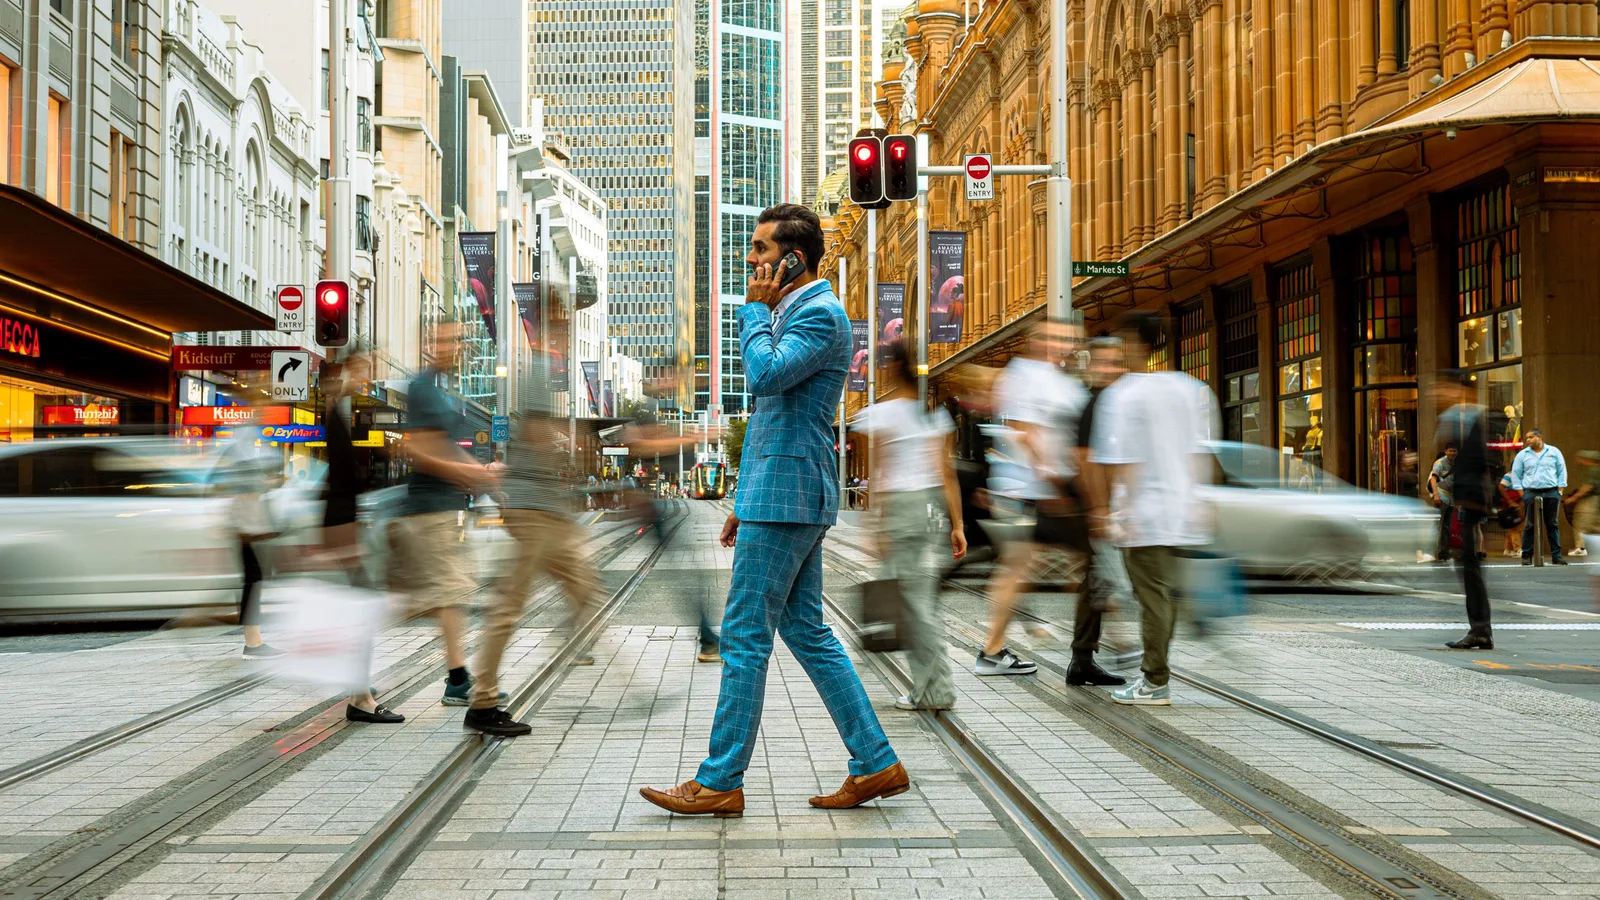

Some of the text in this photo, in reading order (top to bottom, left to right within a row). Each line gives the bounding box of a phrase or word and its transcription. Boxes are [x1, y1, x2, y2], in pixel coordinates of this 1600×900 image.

[1087, 265, 1126, 274] Market St
[180, 350, 236, 364] Kidstuff
[274, 387, 305, 396] ONLY
[274, 428, 319, 438] EzyMart
